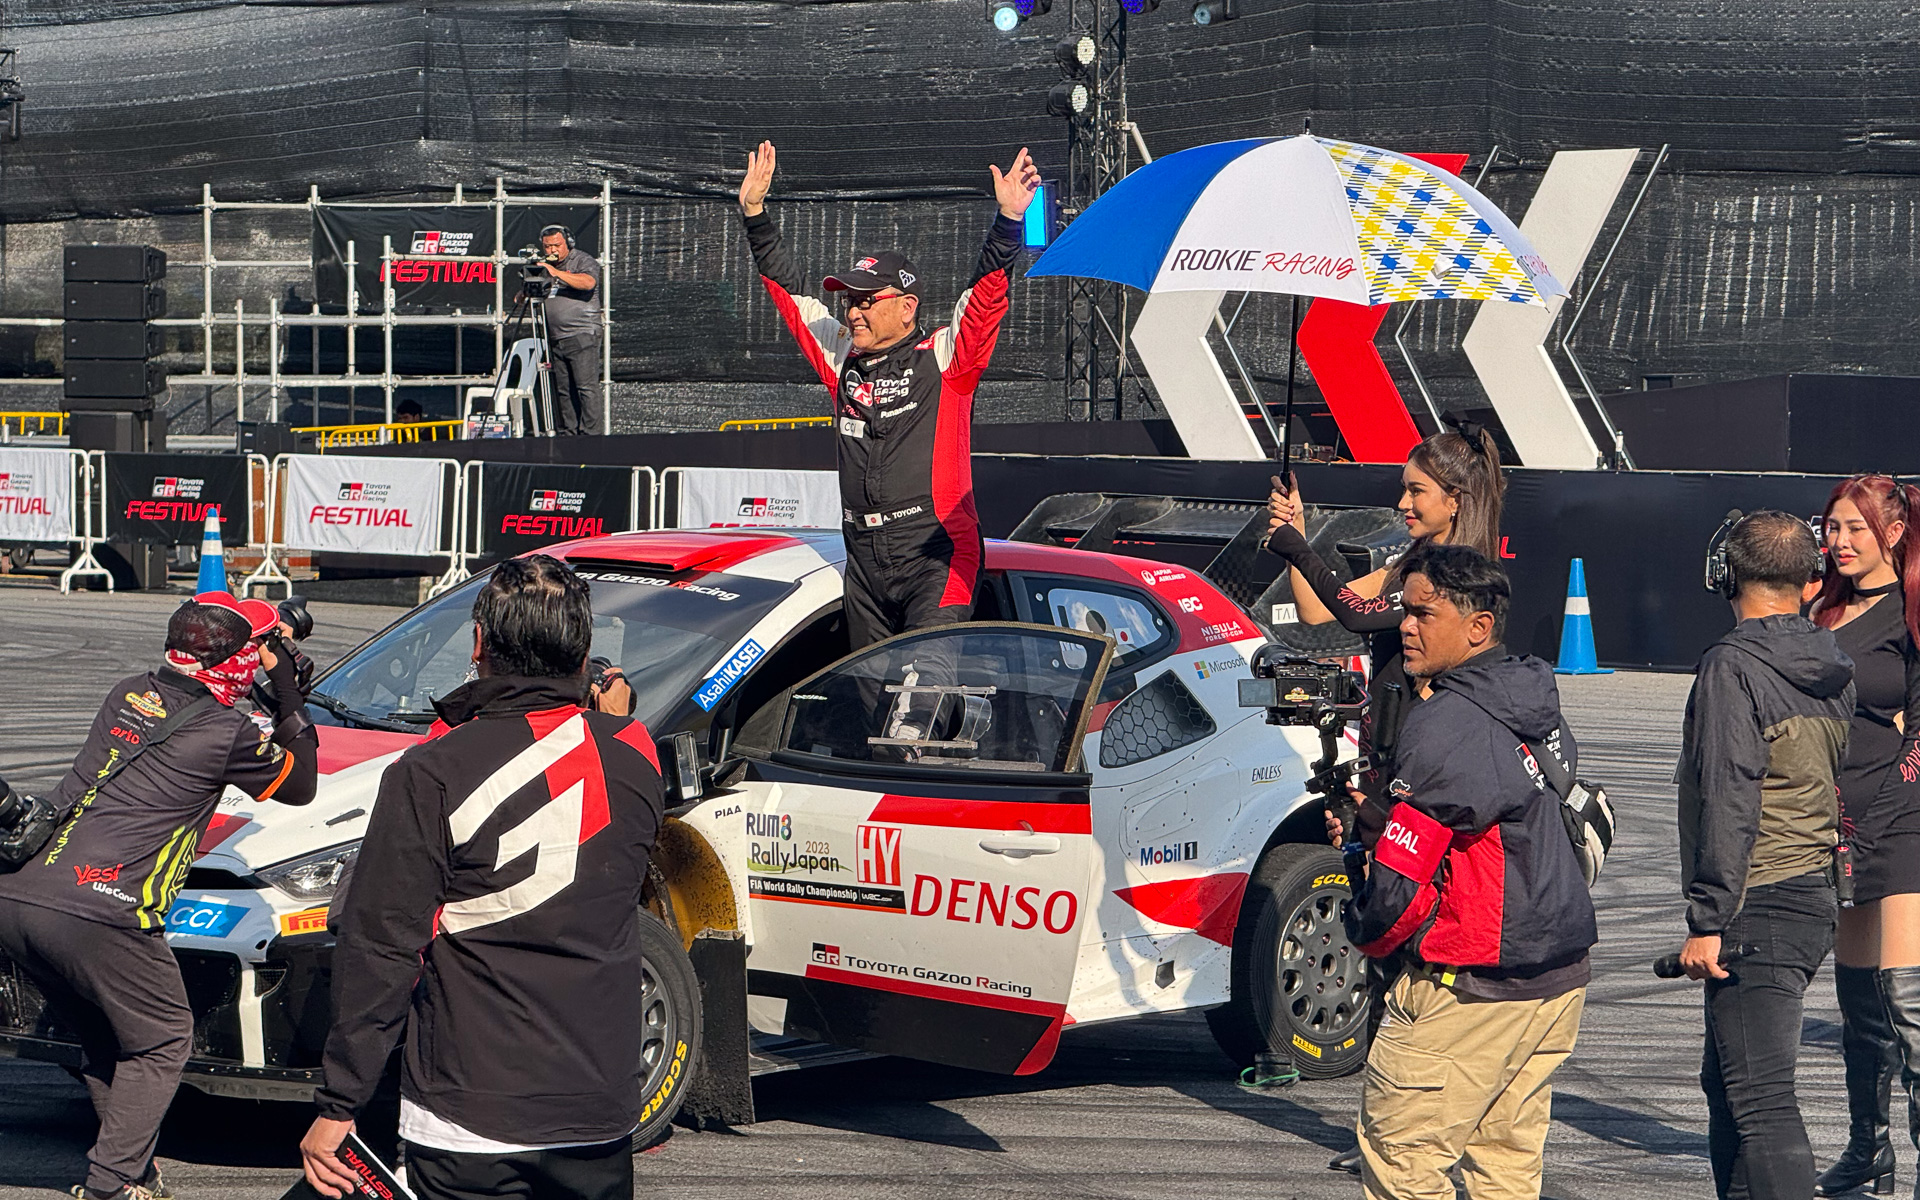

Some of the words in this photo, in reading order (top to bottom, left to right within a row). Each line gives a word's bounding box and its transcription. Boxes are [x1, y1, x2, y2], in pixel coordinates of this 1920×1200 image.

[439, 239, 470, 247] GAZOO
[441, 231, 474, 240] TOYOTA
[411, 240, 439, 253] GR
[438, 246, 468, 255] Racing
[379, 260, 497, 283] FESTIVAL
[1170, 249, 1262, 271] ROOKIE
[1261, 252, 1357, 280] RACING
[154, 484, 174, 495] GR
[175, 491, 201, 499] Racing
[338, 488, 361, 500] GR
[558, 490, 586, 498] TOYOTA
[361, 495, 387, 503] Racing
[531, 497, 556, 509] GR
[126, 500, 227, 523] FESTIVAL
[309, 505, 413, 527] FESTIVAL
[555, 504, 581, 513] Racing
[739, 504, 765, 516] GR
[766, 510, 794, 519] Racing
[891, 505, 923, 519] TOYODA
[501, 514, 612, 538] FESTIVAL
[1153, 568, 1172, 577] JAPAN
[1159, 573, 1187, 582] AIRLINES
[597, 572, 670, 587] GAZOO
[668, 580, 741, 601] Racing
[1200, 621, 1241, 636] NISULA
[1208, 655, 1248, 673] Microsoft
[109, 726, 140, 745] arto
[1251, 764, 1283, 783] ENDLESS
[714, 805, 742, 819] PIAA
[1383, 820, 1420, 855] ICIAL
[805, 840, 831, 855] 2023
[1140, 843, 1182, 867] Mobil
[751, 841, 840, 875] RallyJapan
[858, 827, 901, 885] HY
[92, 881, 137, 904] WeCann
[750, 879, 764, 891] FIA
[762, 881, 786, 893] World
[786, 885, 805, 898] Rally
[806, 885, 858, 901] Championship
[910, 873, 1078, 935] DENSO
[170, 906, 223, 930] CCi
[813, 951, 840, 965] GR
[845, 955, 909, 976] TOYOTA
[913, 966, 972, 986] GAZOO
[976, 976, 1032, 998] Racing
[639, 1039, 688, 1123] SCORP
